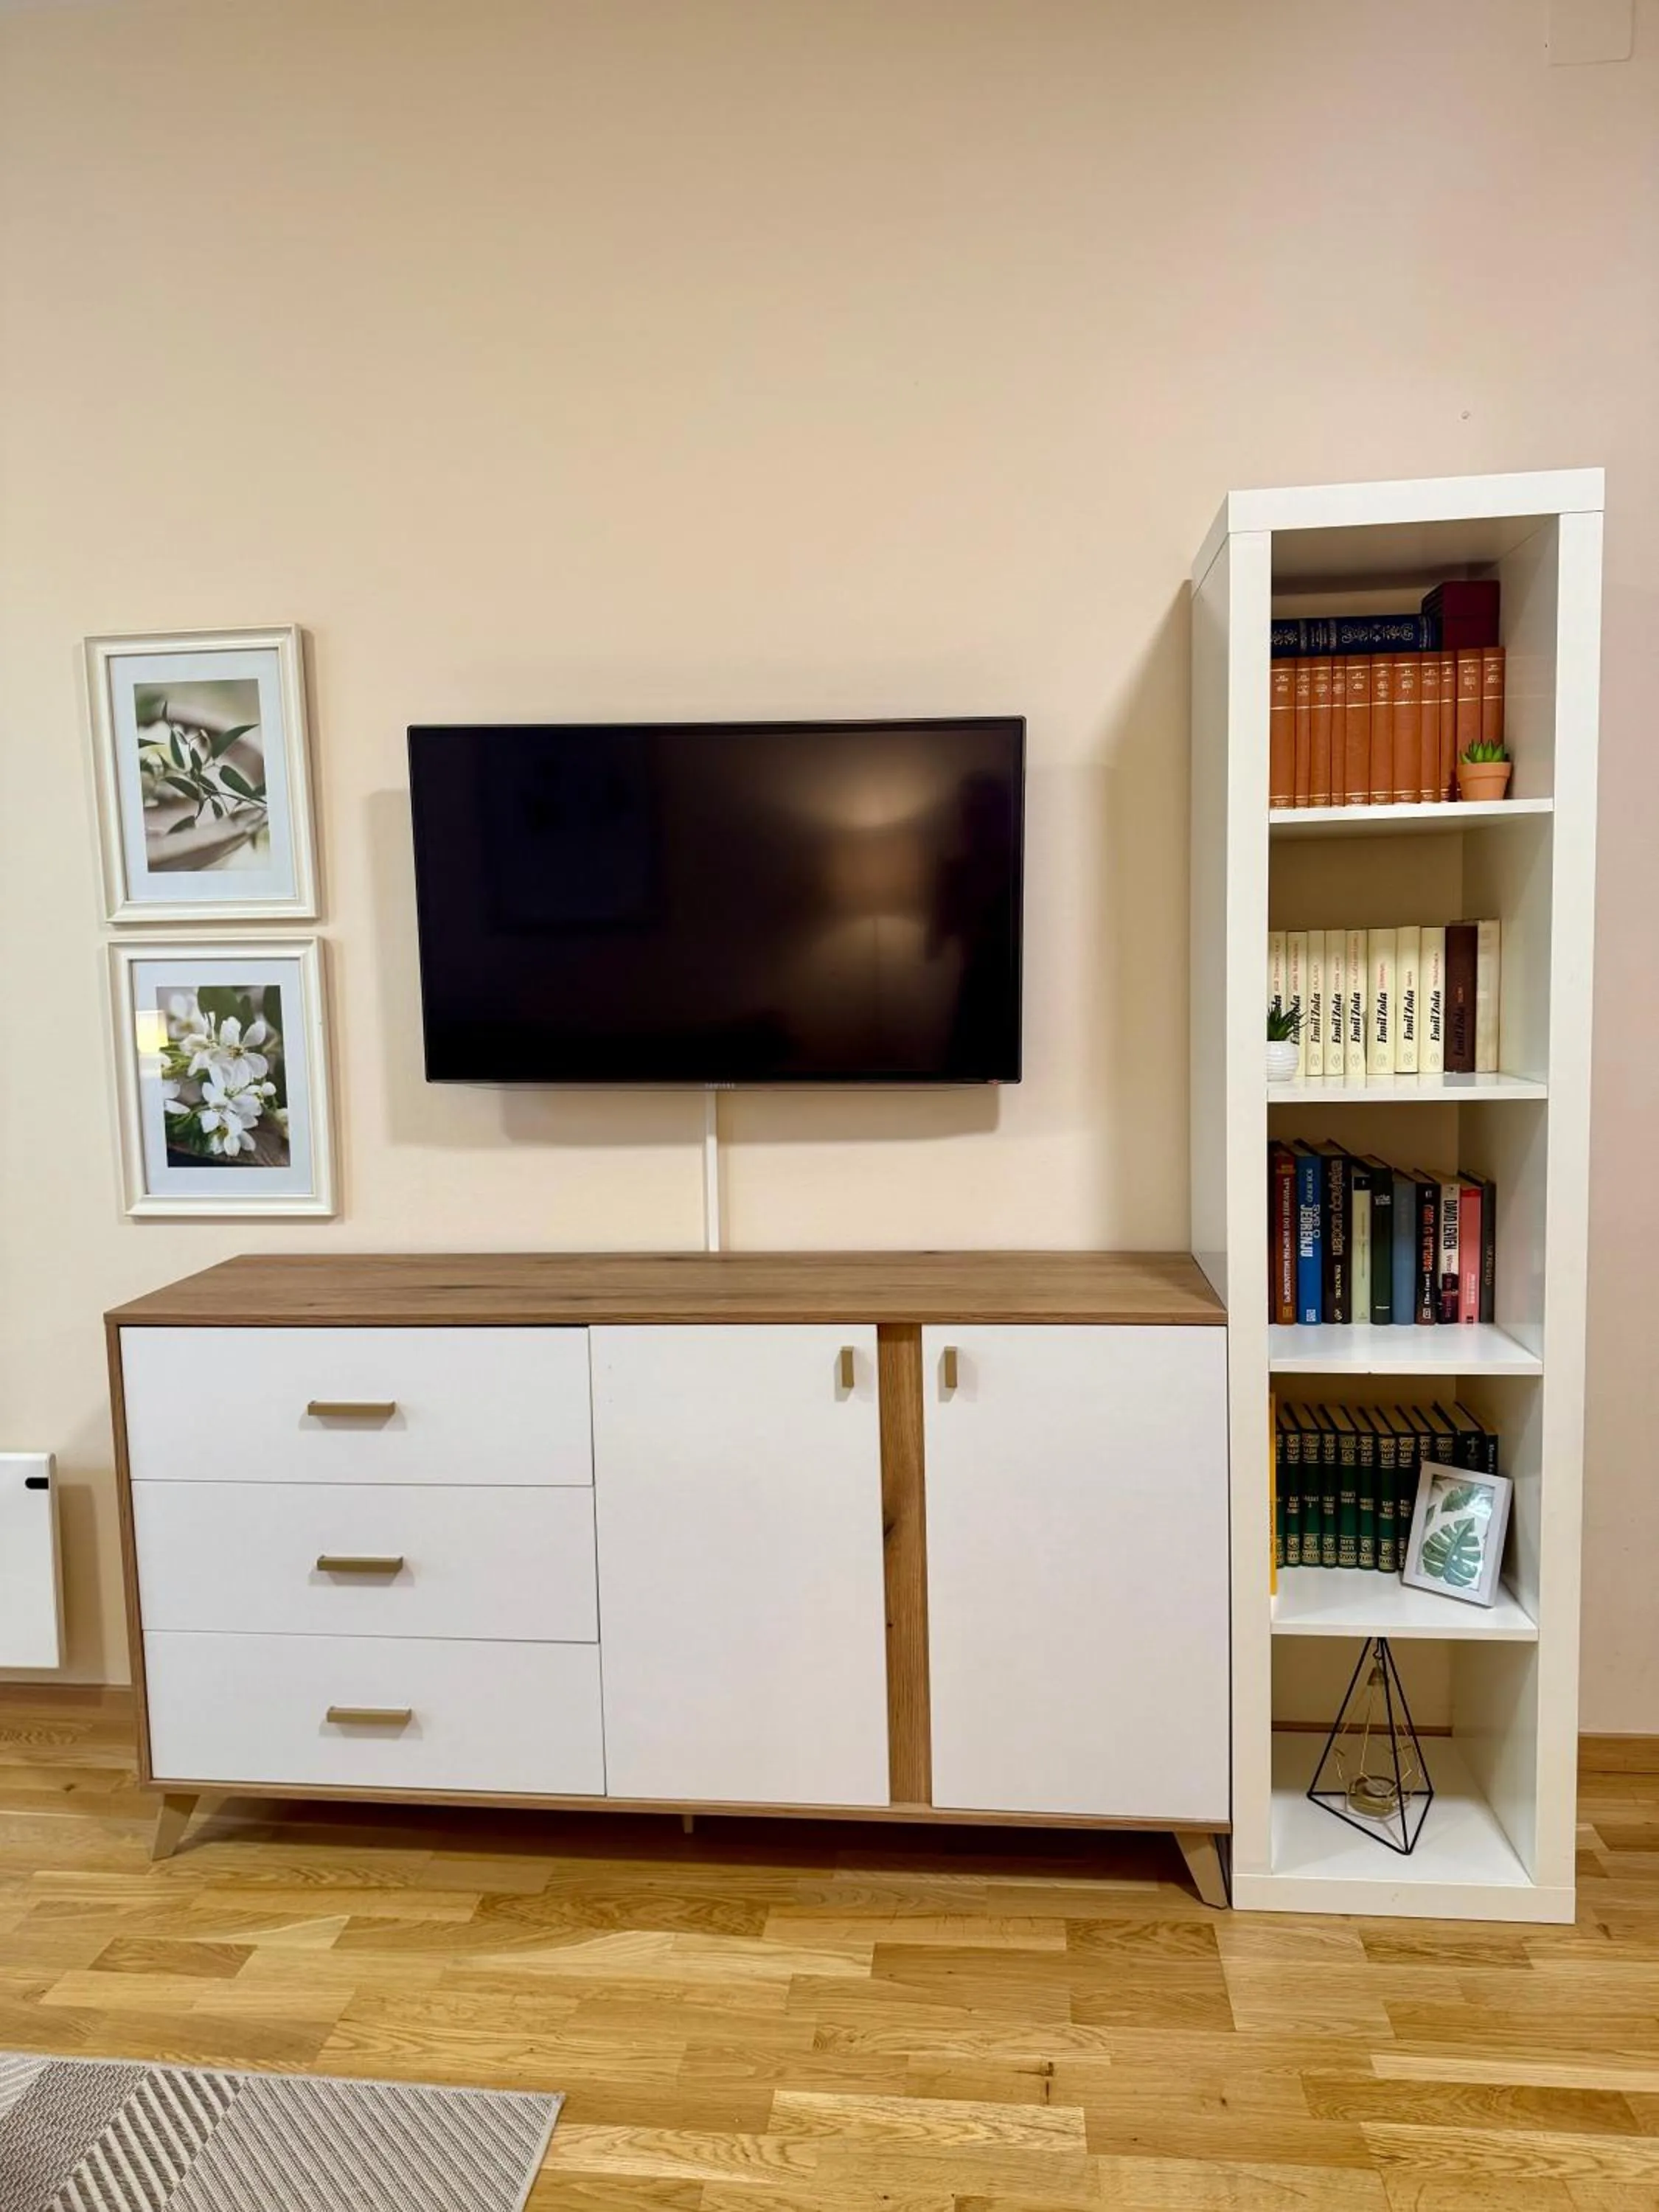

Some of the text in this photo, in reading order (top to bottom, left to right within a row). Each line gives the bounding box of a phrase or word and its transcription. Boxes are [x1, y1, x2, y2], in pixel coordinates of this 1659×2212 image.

[1310, 993, 1320, 1016] Zola
[1331, 993, 1341, 1017] Zola
[1350, 992, 1360, 1016] Zola
[1377, 992, 1387, 1016] Zola
[1404, 990, 1414, 1014] Zola
[1430, 991, 1440, 1015] Zola
[1310, 1018, 1320, 1043] Emil
[1331, 1018, 1341, 1043] Emil
[1350, 1018, 1360, 1043] Emil
[1377, 1018, 1387, 1043] Emil
[1404, 1015, 1414, 1040] Emil
[1430, 1016, 1440, 1041] Emil
[1443, 1200, 1458, 1222] DAVID
[1300, 1204, 1313, 1257] JEDRENJU
[1443, 1223, 1458, 1250] LEVIEN
